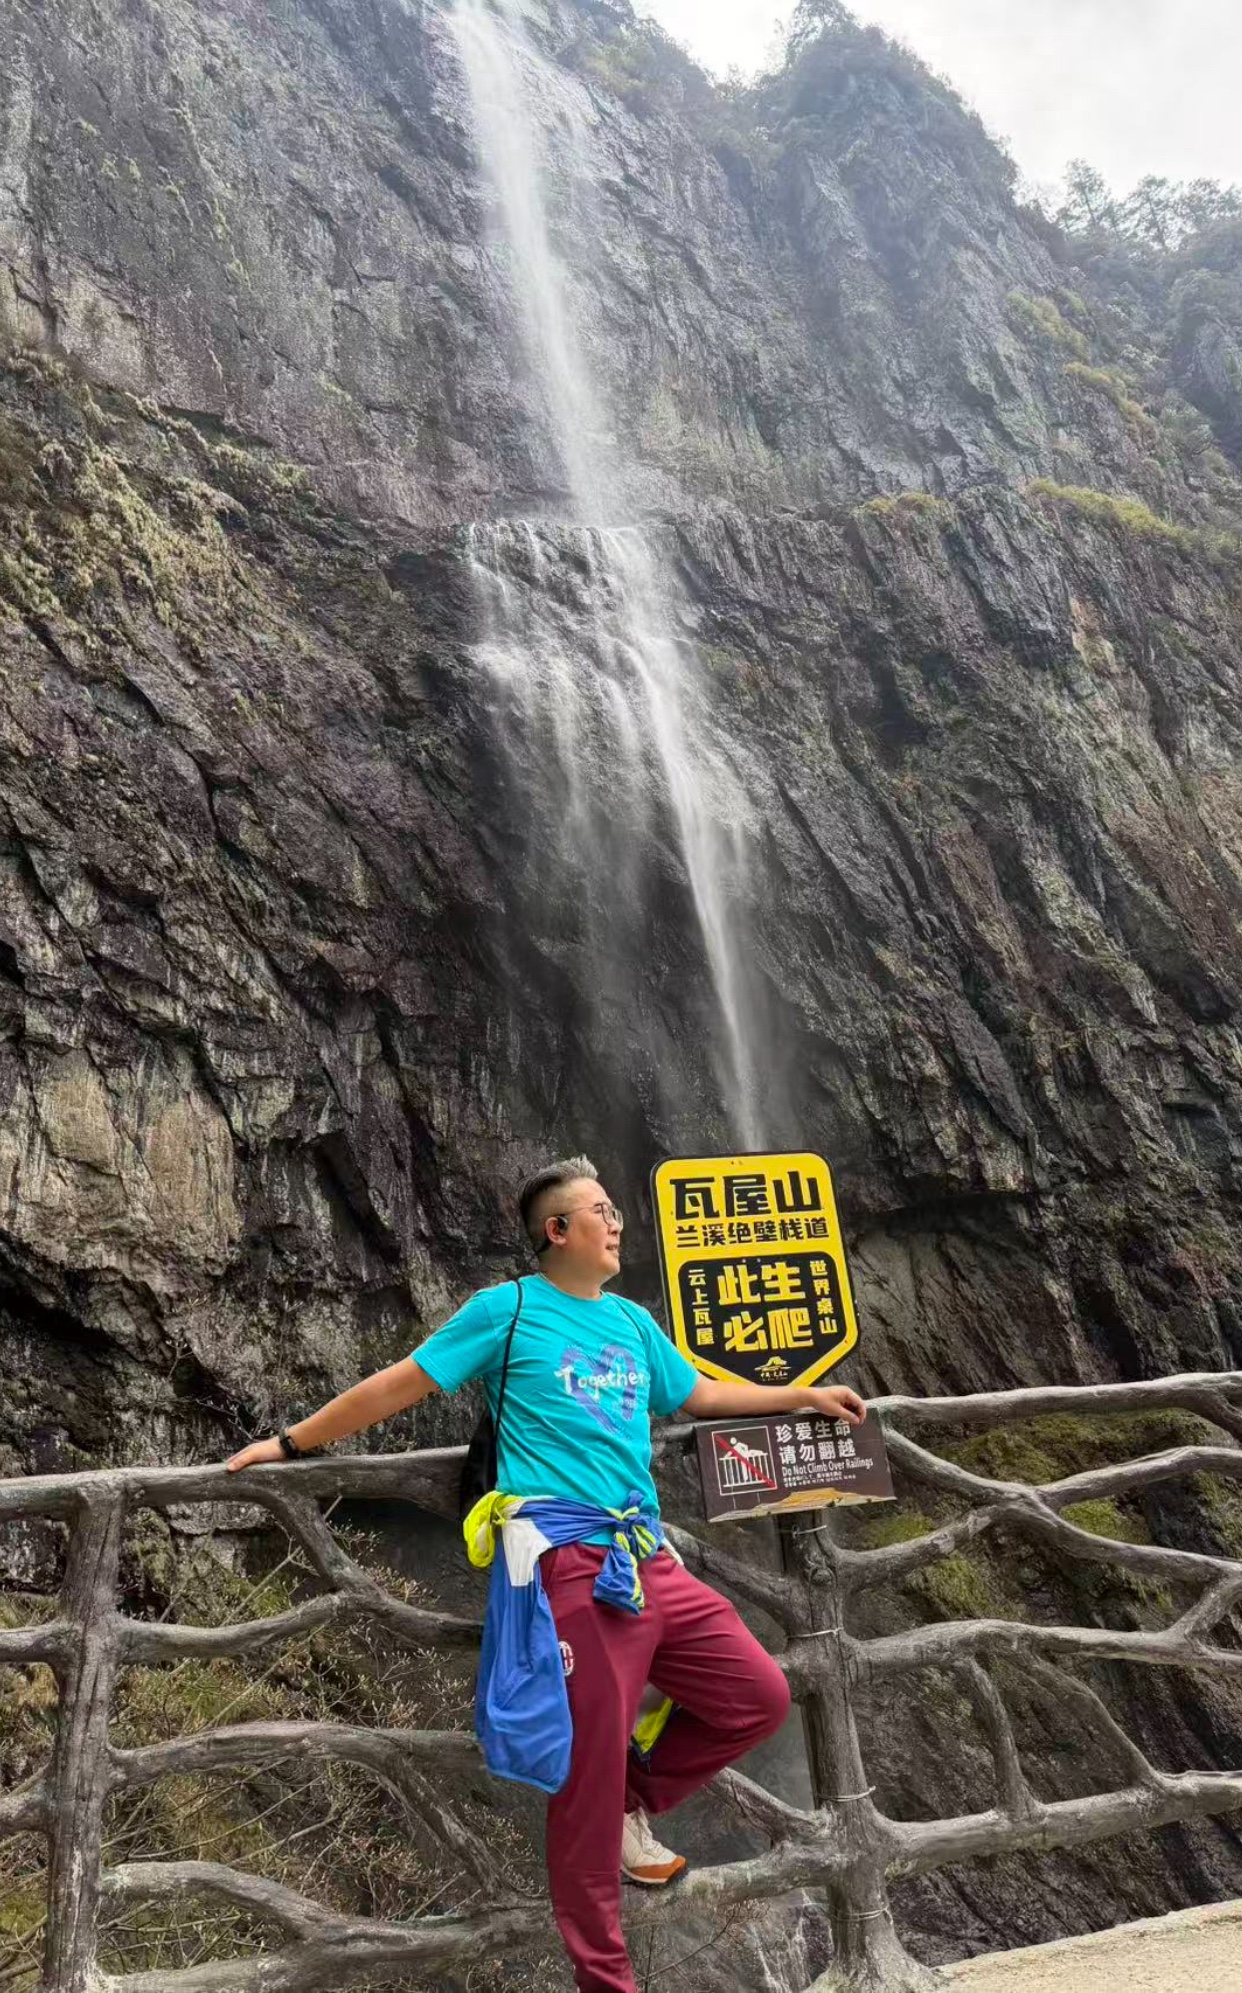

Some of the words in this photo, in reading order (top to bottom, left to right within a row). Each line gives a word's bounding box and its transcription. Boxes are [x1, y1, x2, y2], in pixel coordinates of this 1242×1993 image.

[670, 1170, 822, 1220] 瓦屋山
[676, 1217, 829, 1248] 兰溪绝壁栈道
[717, 1261, 806, 1306] 此生
[688, 1269, 714, 1346] 云上瓦屋
[723, 1307, 814, 1352] 必爬
[554, 1365, 645, 1400] Together
[775, 1418, 851, 1444] 珍爱生命
[779, 1438, 856, 1465] 请勿翻越
[781, 1466, 792, 1477] Do
[793, 1464, 807, 1476] Not
[807, 1461, 828, 1473] Climb
[828, 1460, 845, 1471] Over
[845, 1457, 874, 1470] Railings
